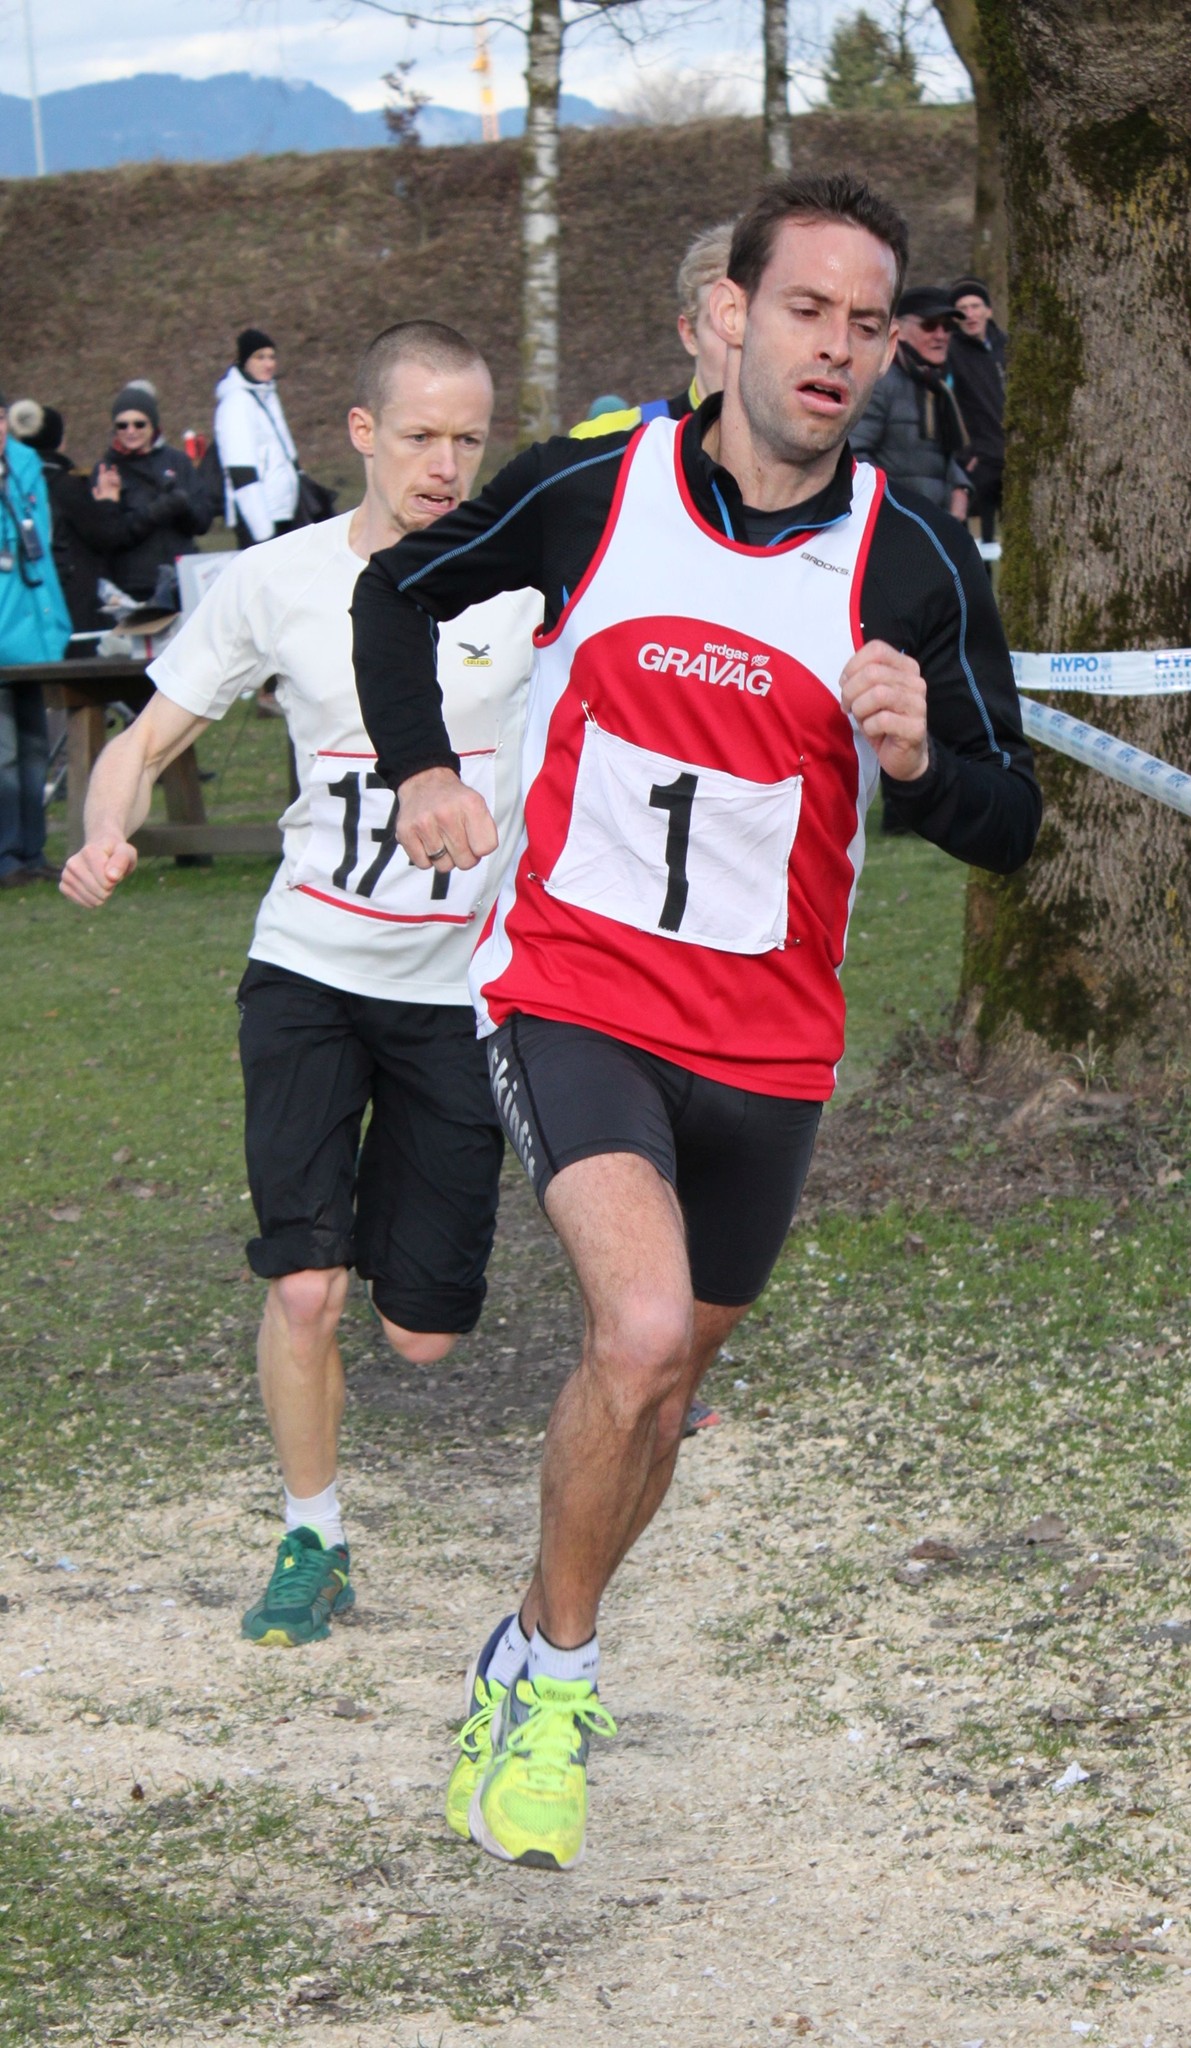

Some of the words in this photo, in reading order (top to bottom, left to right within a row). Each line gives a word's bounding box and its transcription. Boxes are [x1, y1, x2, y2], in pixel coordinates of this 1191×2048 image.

[801, 552, 849, 576] BROOKS
[637, 643, 772, 697] GRAVAG
[703, 642, 749, 661] erdgas
[1050, 656, 1099, 672] HYPO
[327, 771, 452, 900] 17
[648, 771, 699, 933] 1
